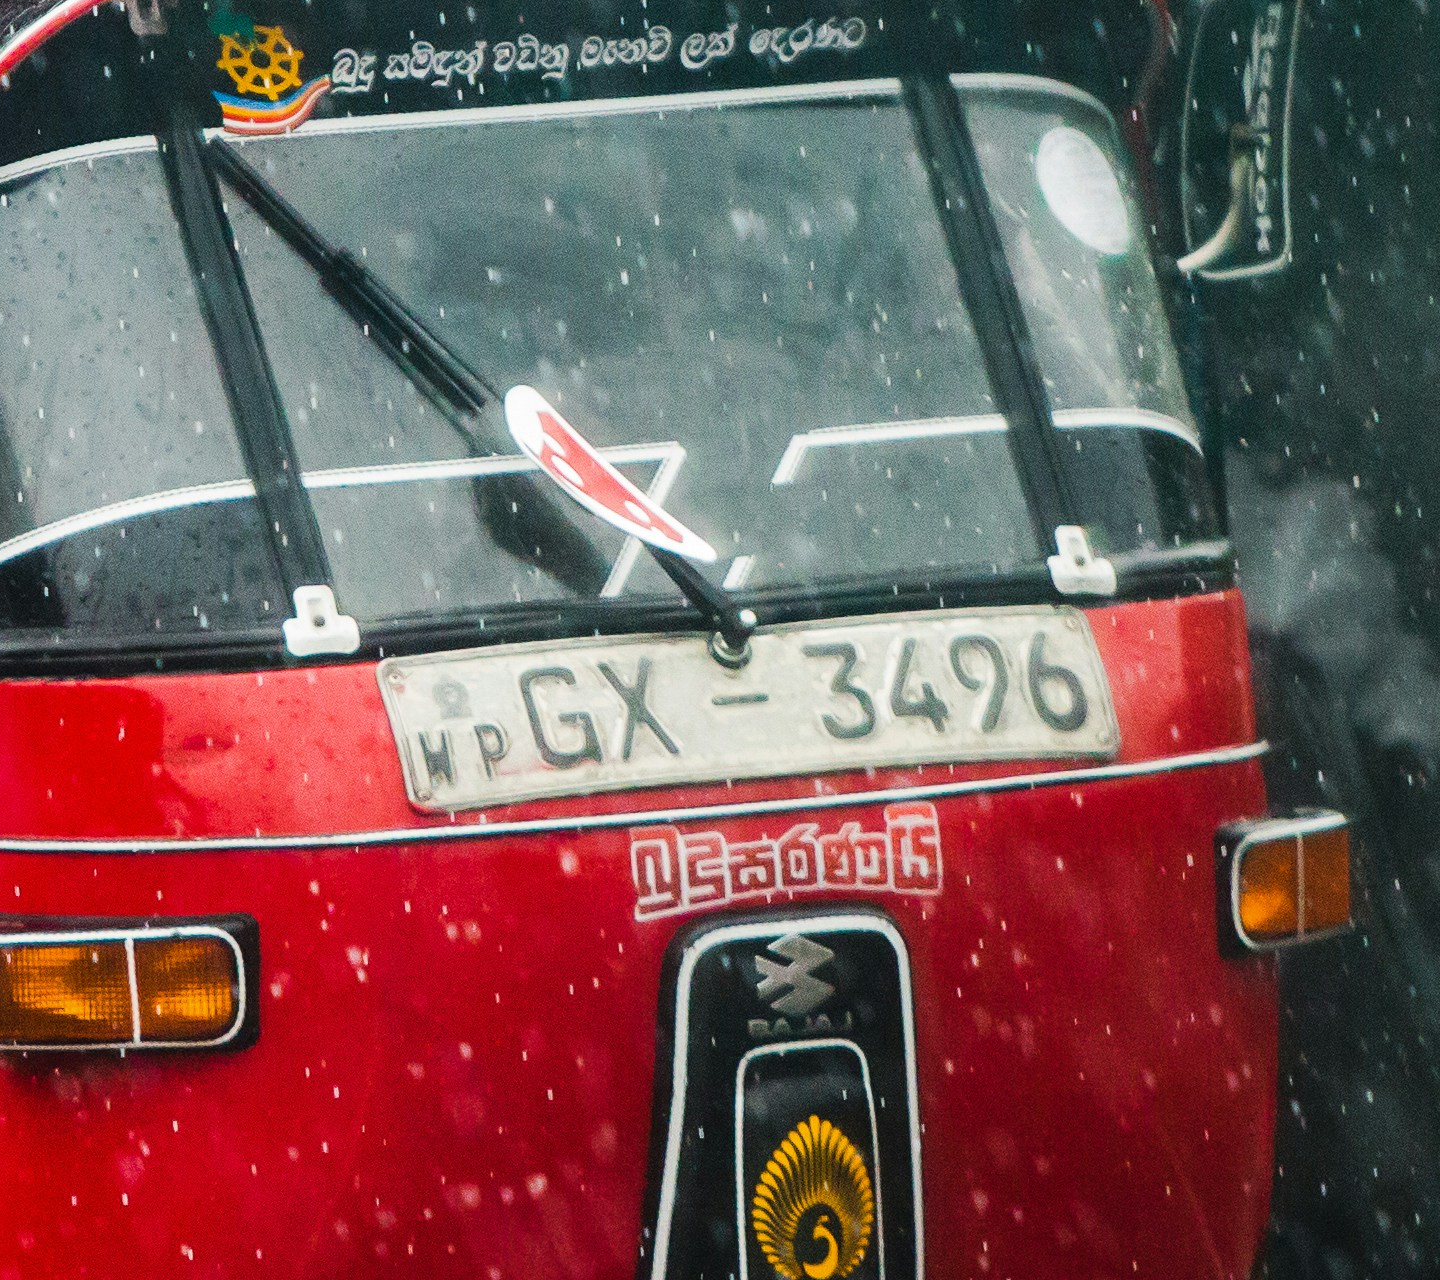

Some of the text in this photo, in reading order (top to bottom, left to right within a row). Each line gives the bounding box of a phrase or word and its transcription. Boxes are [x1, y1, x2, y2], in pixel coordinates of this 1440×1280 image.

[331, 47, 376, 94] බුදු
[493, 32, 570, 81] වඩිනු
[416, 718, 510, 787] WP
[519, 657, 679, 767] GX
[801, 630, 1089, 743] 3496
